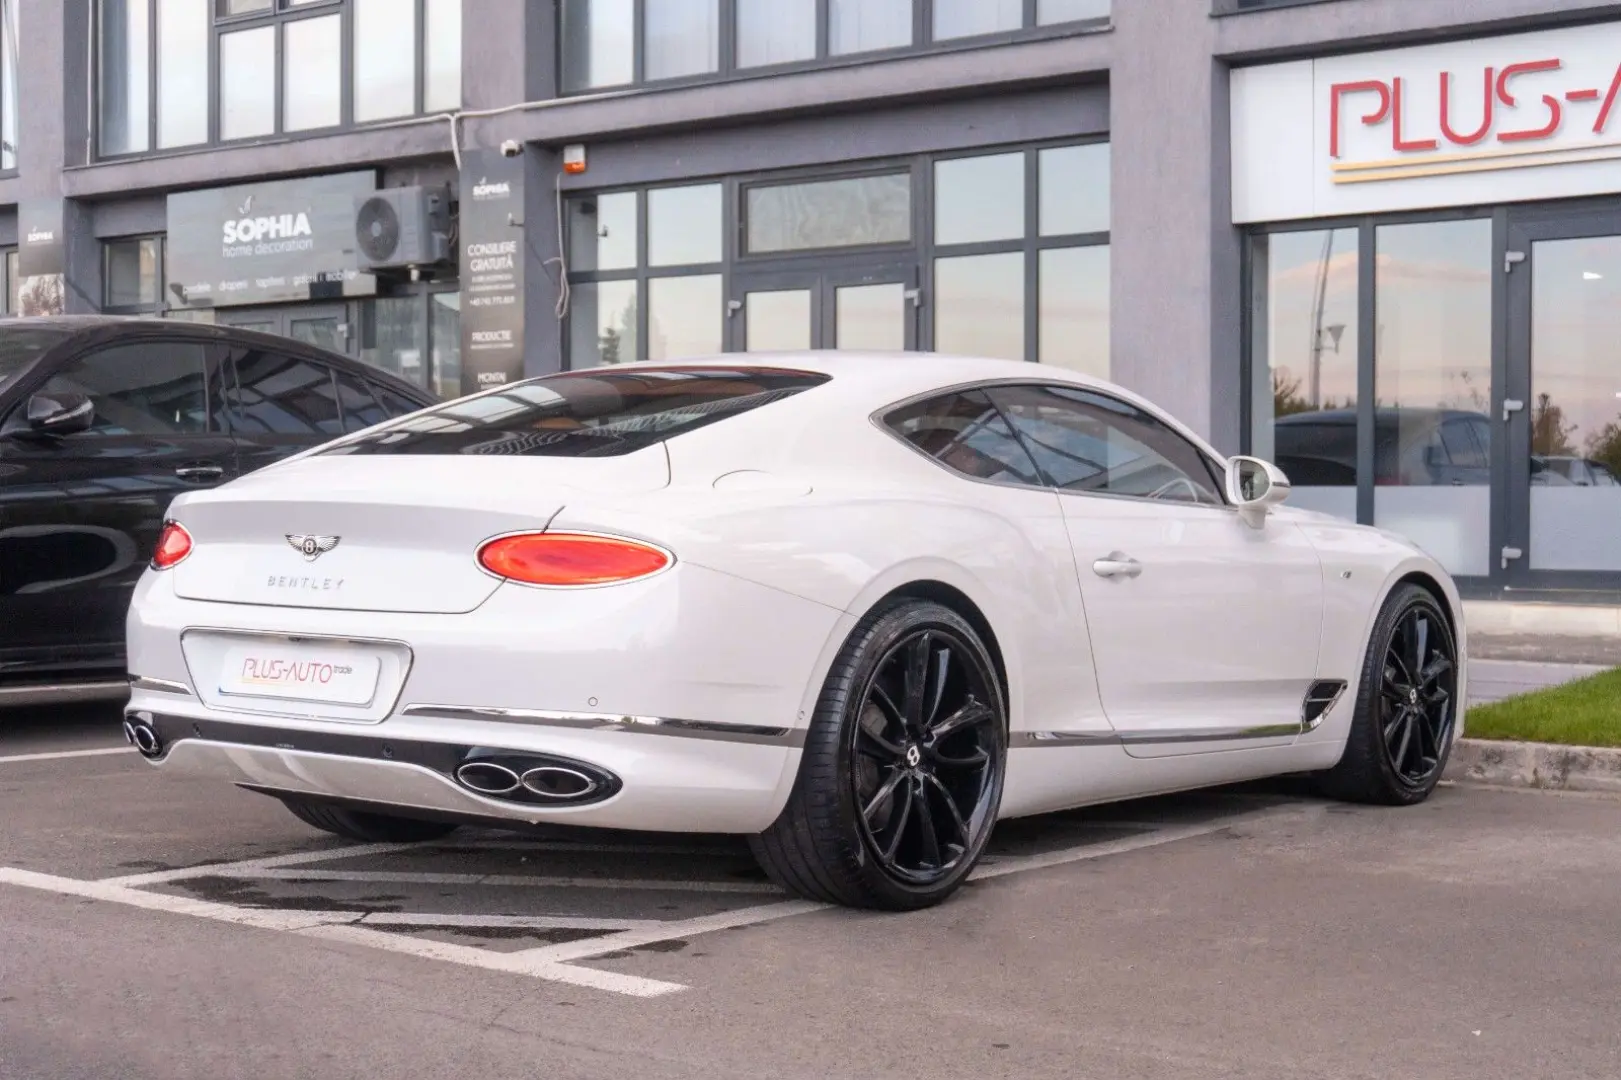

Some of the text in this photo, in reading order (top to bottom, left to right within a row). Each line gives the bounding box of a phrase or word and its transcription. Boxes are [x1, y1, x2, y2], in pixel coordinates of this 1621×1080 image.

[223, 212, 312, 244] SOPHIA
[222, 238, 314, 258] home decoration
[467, 240, 517, 256] CONSILIERE
[267, 575, 344, 590] BENTLEY
[242, 658, 332, 684] PLUS-AUTO
